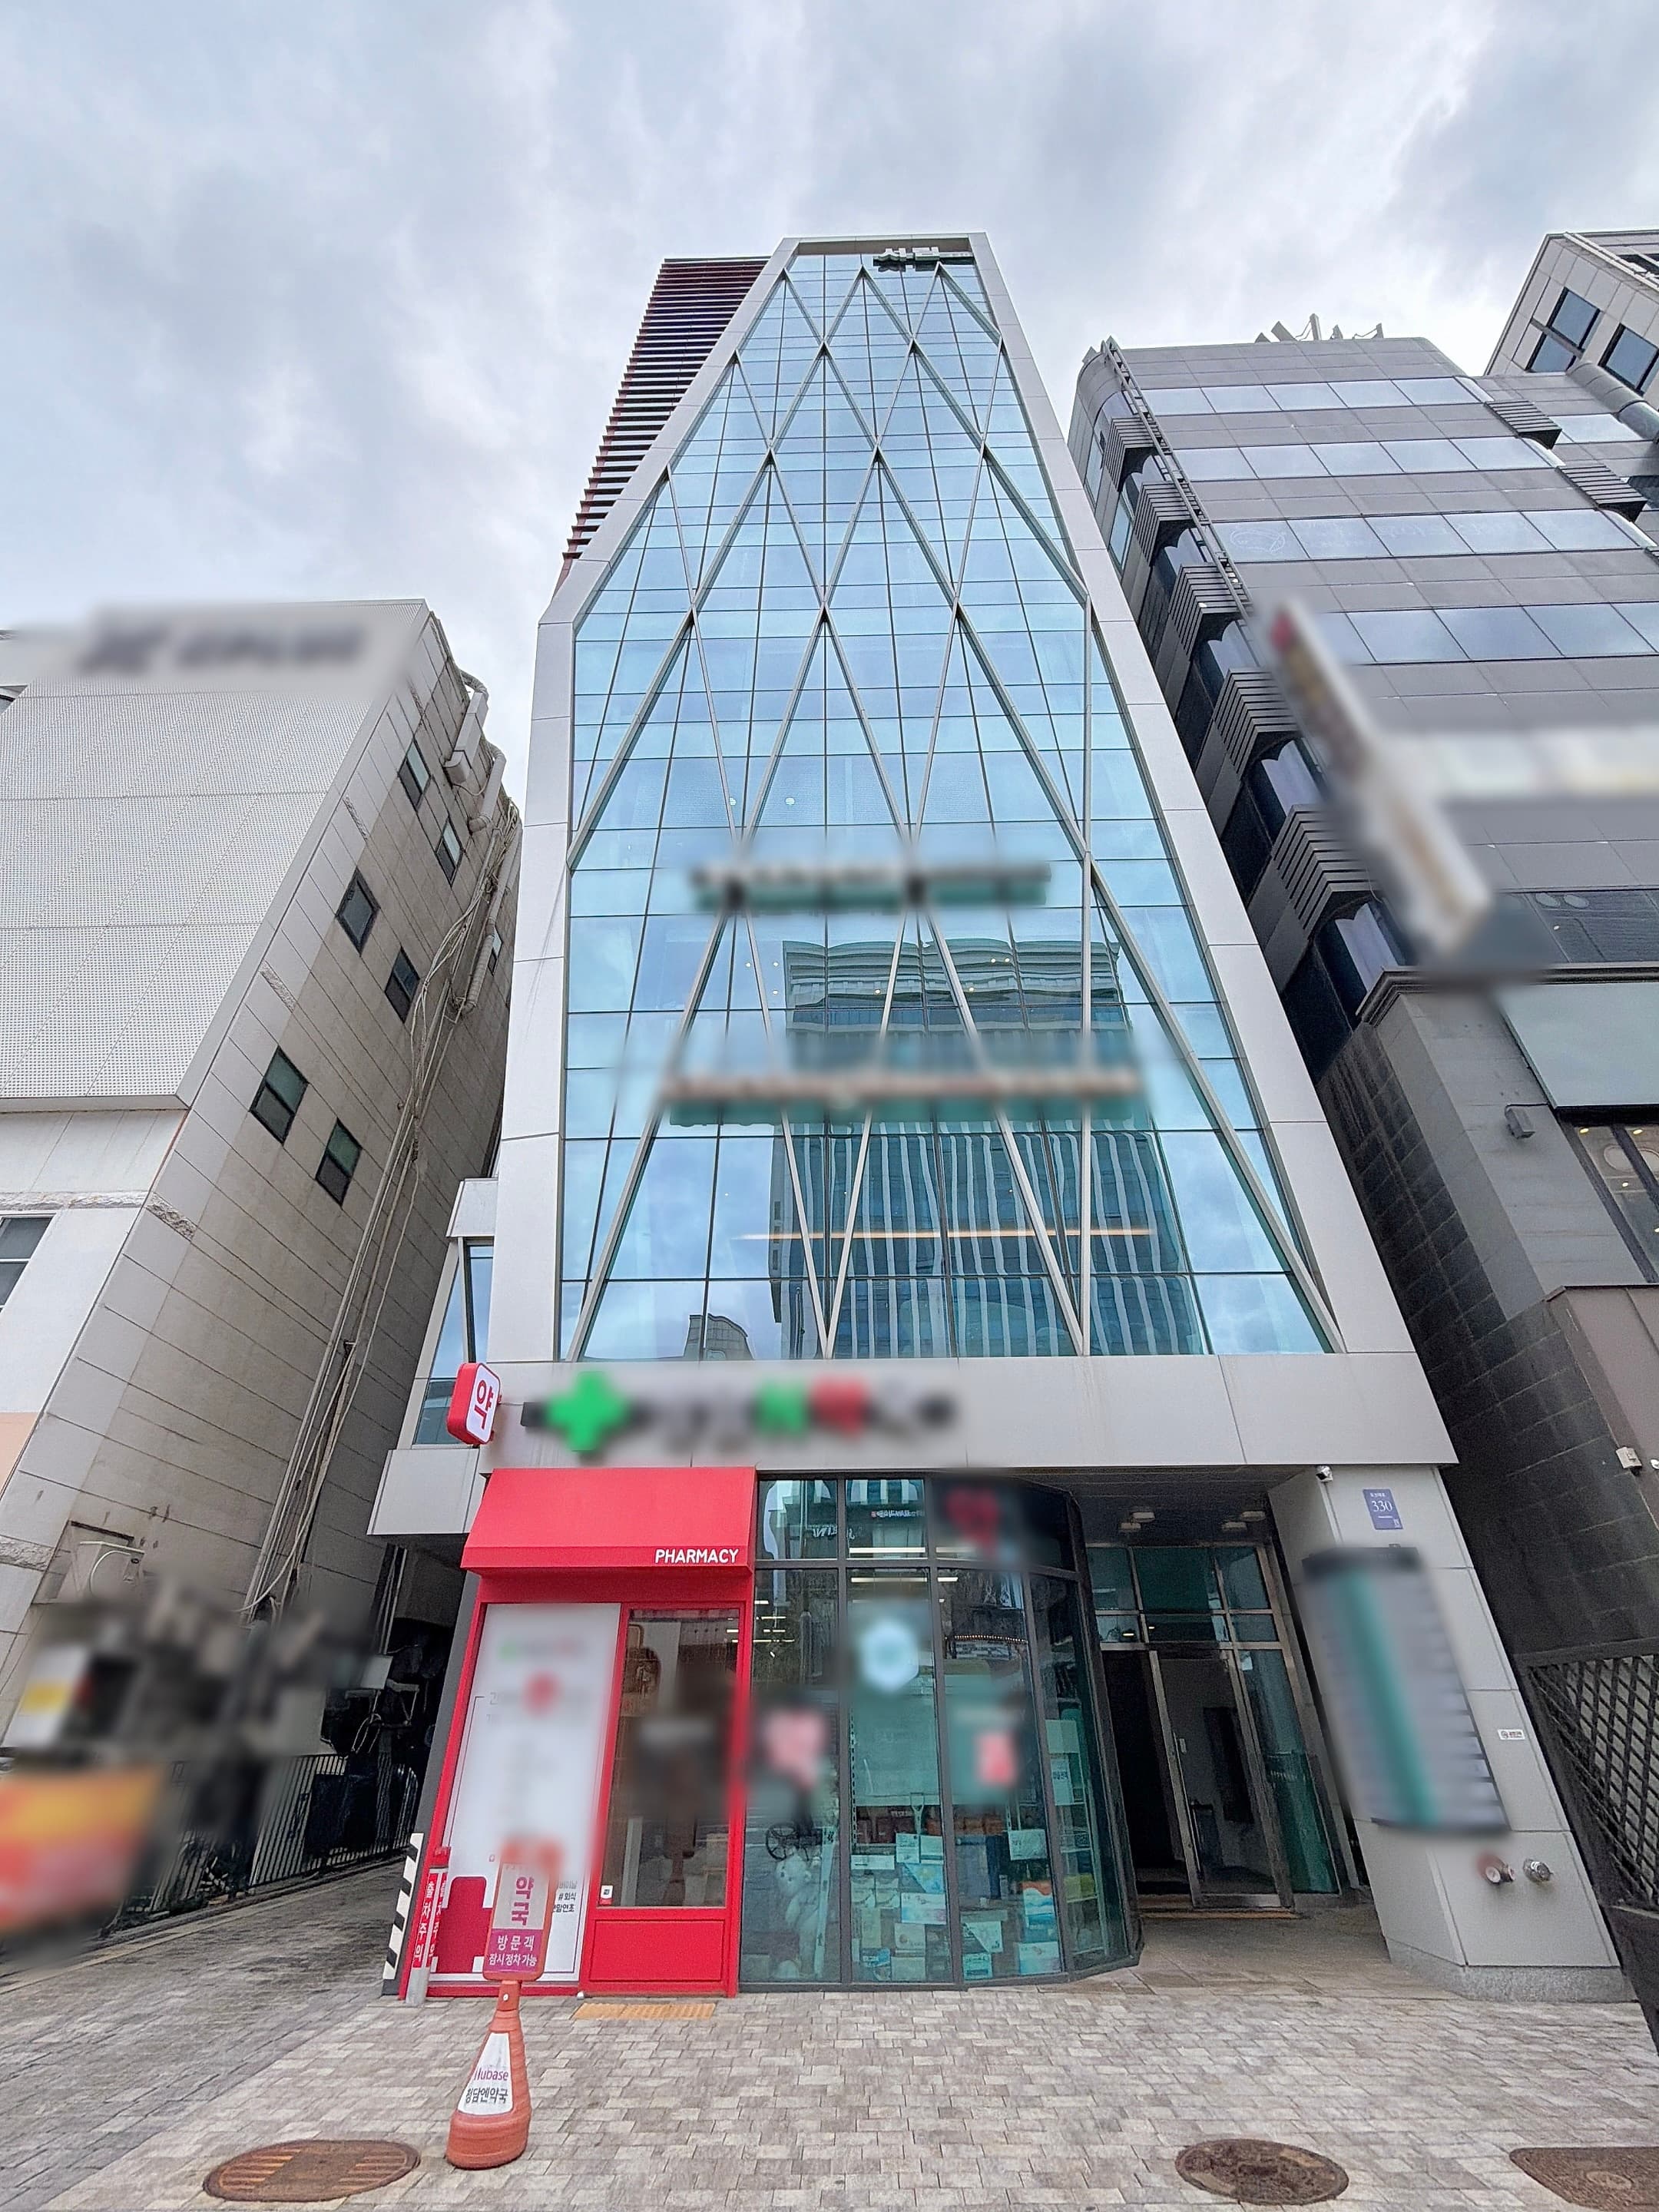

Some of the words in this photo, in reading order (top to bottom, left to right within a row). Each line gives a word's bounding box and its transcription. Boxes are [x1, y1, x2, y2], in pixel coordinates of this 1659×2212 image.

[474, 1380, 493, 1429] 약
[1371, 1500, 1392, 1512] 330
[655, 1548, 739, 1564] PHARMACY
[416, 1882, 435, 1962] 출차주의
[512, 1876, 534, 1926] 약국
